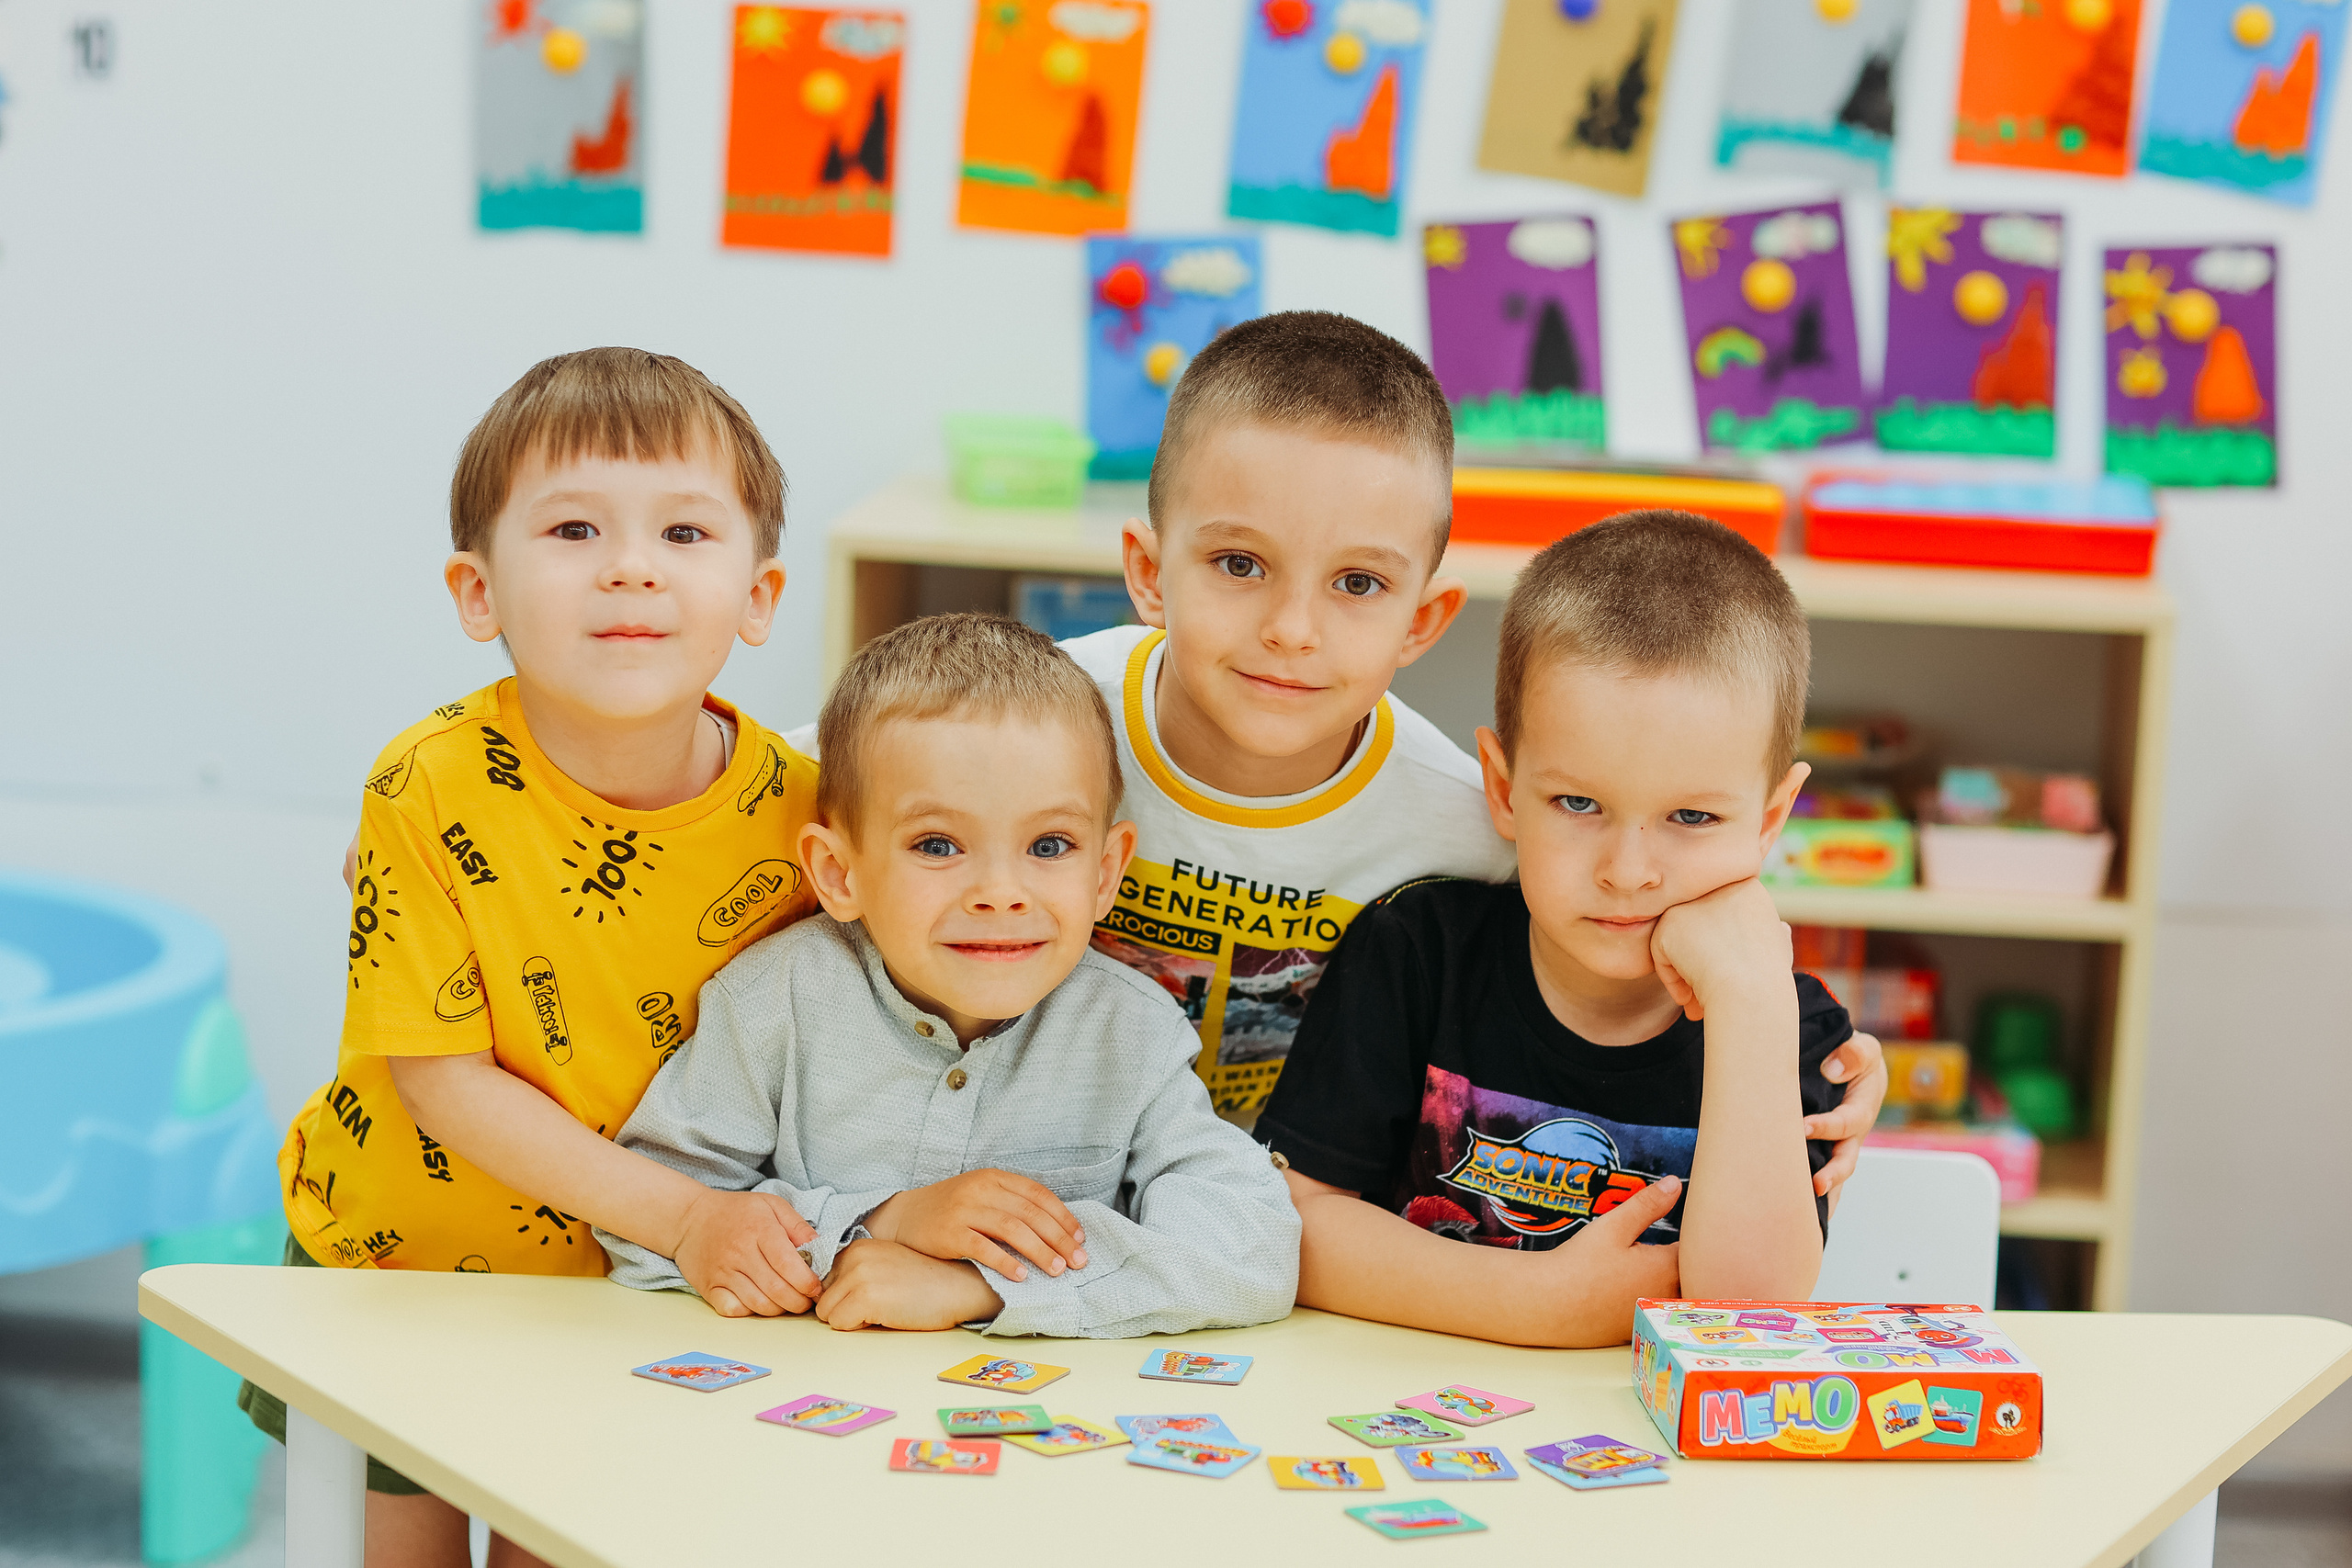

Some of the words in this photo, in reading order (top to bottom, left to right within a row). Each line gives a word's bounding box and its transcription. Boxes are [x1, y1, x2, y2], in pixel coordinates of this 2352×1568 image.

[480, 726, 525, 792] BOY
[441, 821, 498, 886] EASY
[582, 839, 637, 901] 100
[713, 871, 783, 928] COOL
[1118, 876, 1341, 942] GENERATIO
[1171, 858, 1326, 910] FUTURE
[1100, 910, 1214, 951] ROCIOUS
[449, 965, 481, 1000] CO
[1453, 1168, 1594, 1215] ADVENTURE
[1593, 1173, 1647, 1214] 2
[1468, 1139, 1597, 1195] SONIC
[362, 1228, 403, 1254] HEY
